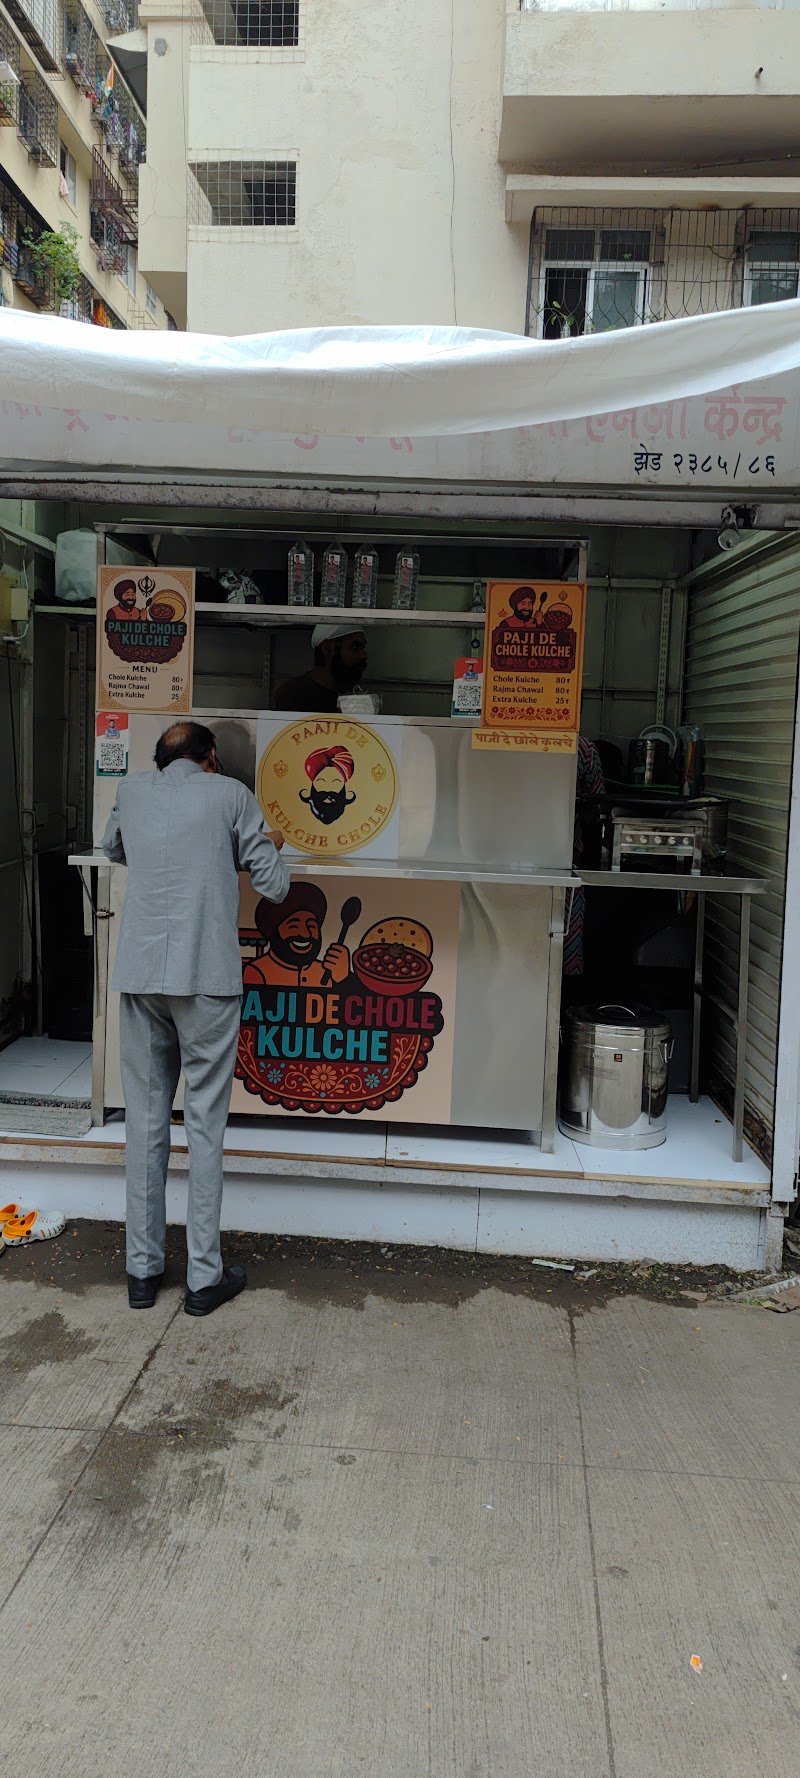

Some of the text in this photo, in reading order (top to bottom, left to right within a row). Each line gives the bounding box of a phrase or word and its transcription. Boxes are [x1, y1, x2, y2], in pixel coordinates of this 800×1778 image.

[633, 443, 664, 476] झेड
[108, 621, 184, 636] PAJI DE CHOLE
[121, 633, 170, 647] KULCHE
[503, 631, 557, 644] PAJI DE
[495, 644, 571, 657] CHOLE KULCHE
[132, 665, 158, 674] MENU
[108, 673, 147, 682] Chole Kulche
[493, 675, 540, 684] Chole Kulche
[108, 682, 150, 691] Rajma Chawal
[493, 686, 544, 694] Rajma Chawal
[125, 691, 145, 699] Kulche
[492, 695, 538, 704] Extra Kulche
[291, 721, 369, 748] PAAJI DE
[474, 731, 574, 752] पाजी दे छोले कुलचे
[267, 800, 387, 847] KULCHE CHOLE
[240, 990, 436, 1030] AJI DE CHOLE
[257, 1025, 389, 1062] KULCHE
